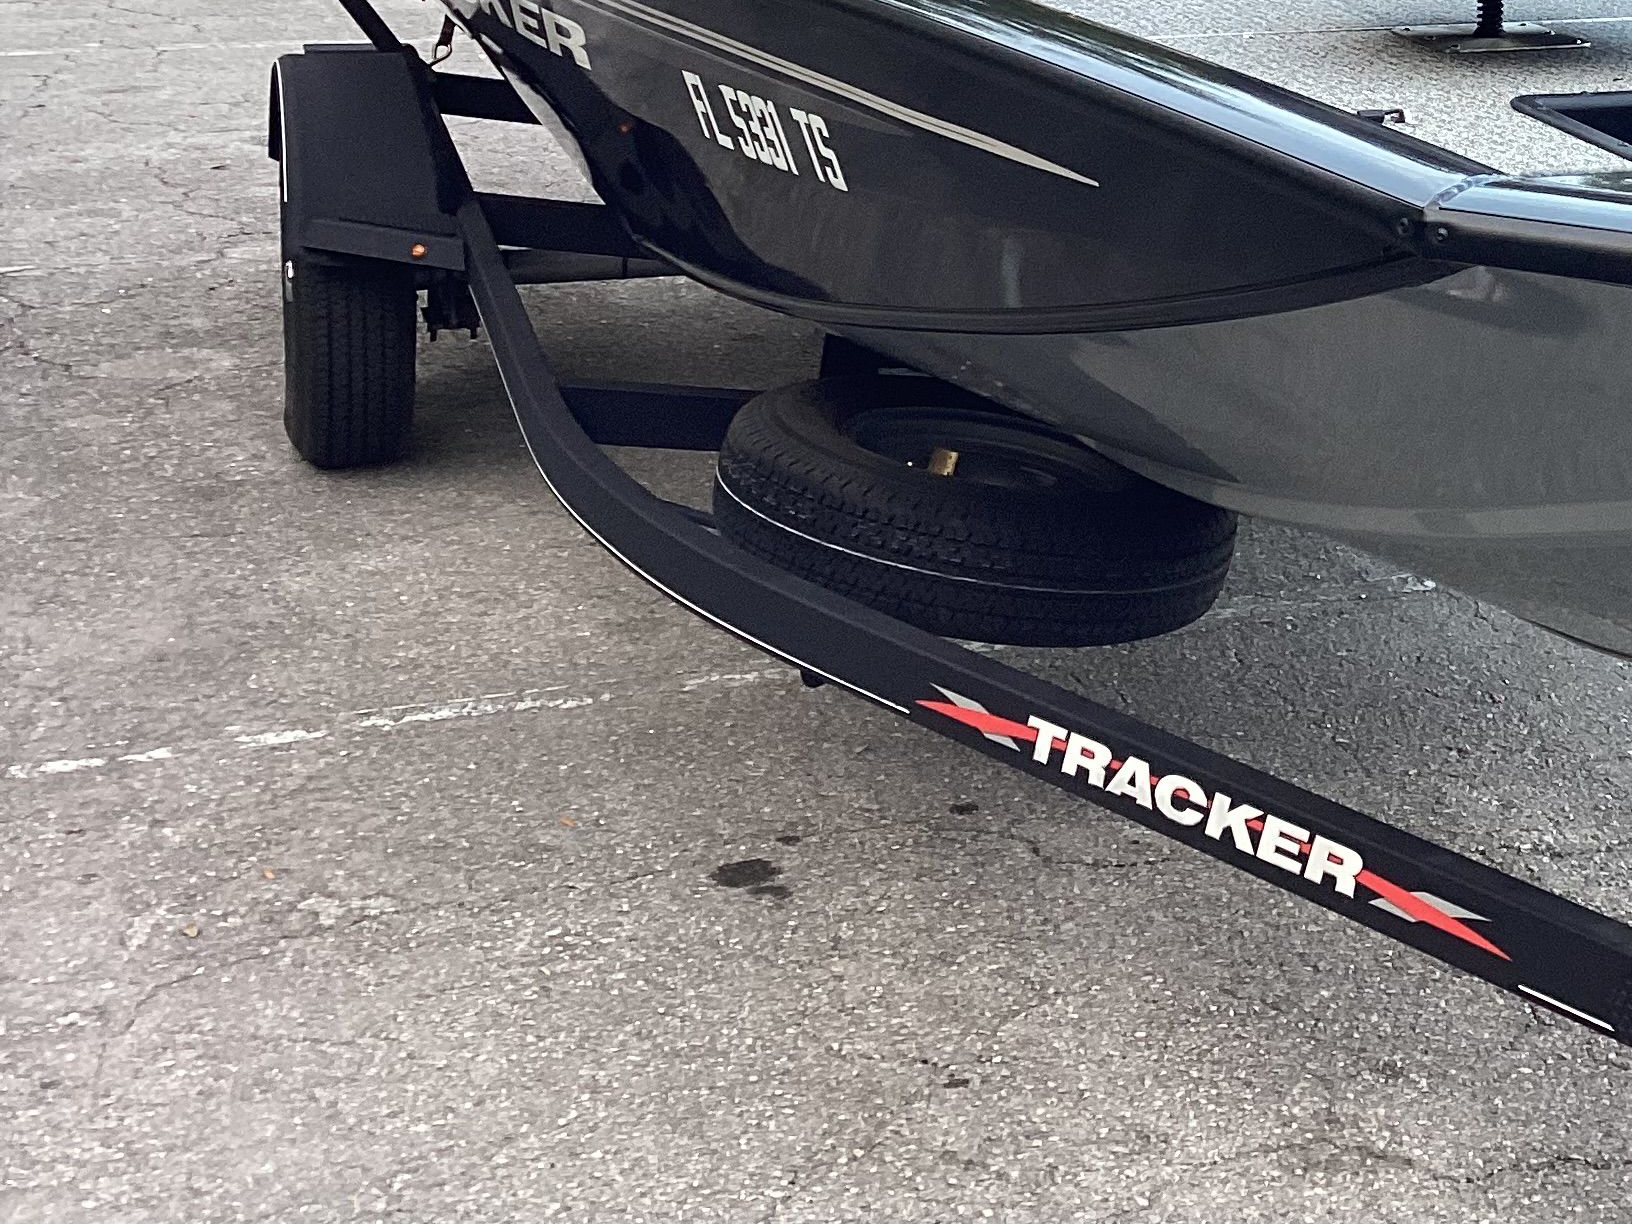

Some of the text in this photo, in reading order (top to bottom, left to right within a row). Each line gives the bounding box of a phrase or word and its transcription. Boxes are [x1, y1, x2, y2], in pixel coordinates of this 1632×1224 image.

[681, 69, 849, 192] FL 5331 TS
[1026, 714, 1365, 899] TRACKER
